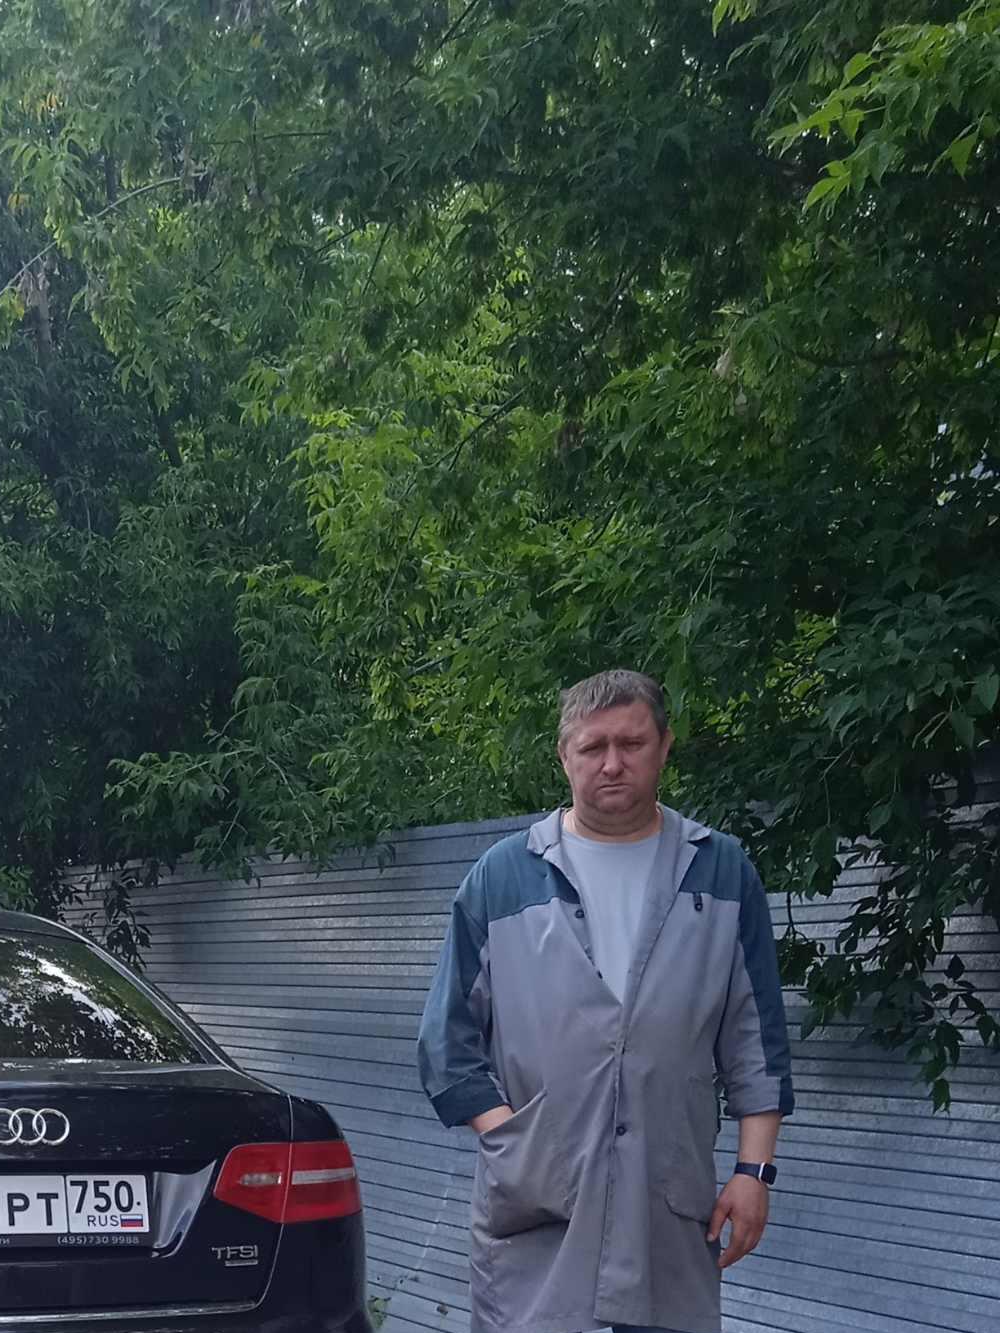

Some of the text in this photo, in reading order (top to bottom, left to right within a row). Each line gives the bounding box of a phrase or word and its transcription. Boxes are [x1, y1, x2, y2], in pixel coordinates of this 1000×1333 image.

[69, 1180, 134, 1214] 750
[87, 1214, 120, 1227] RUS
[57, 1235, 87, 1245] (495)
[211, 1244, 258, 1260] TFSI
